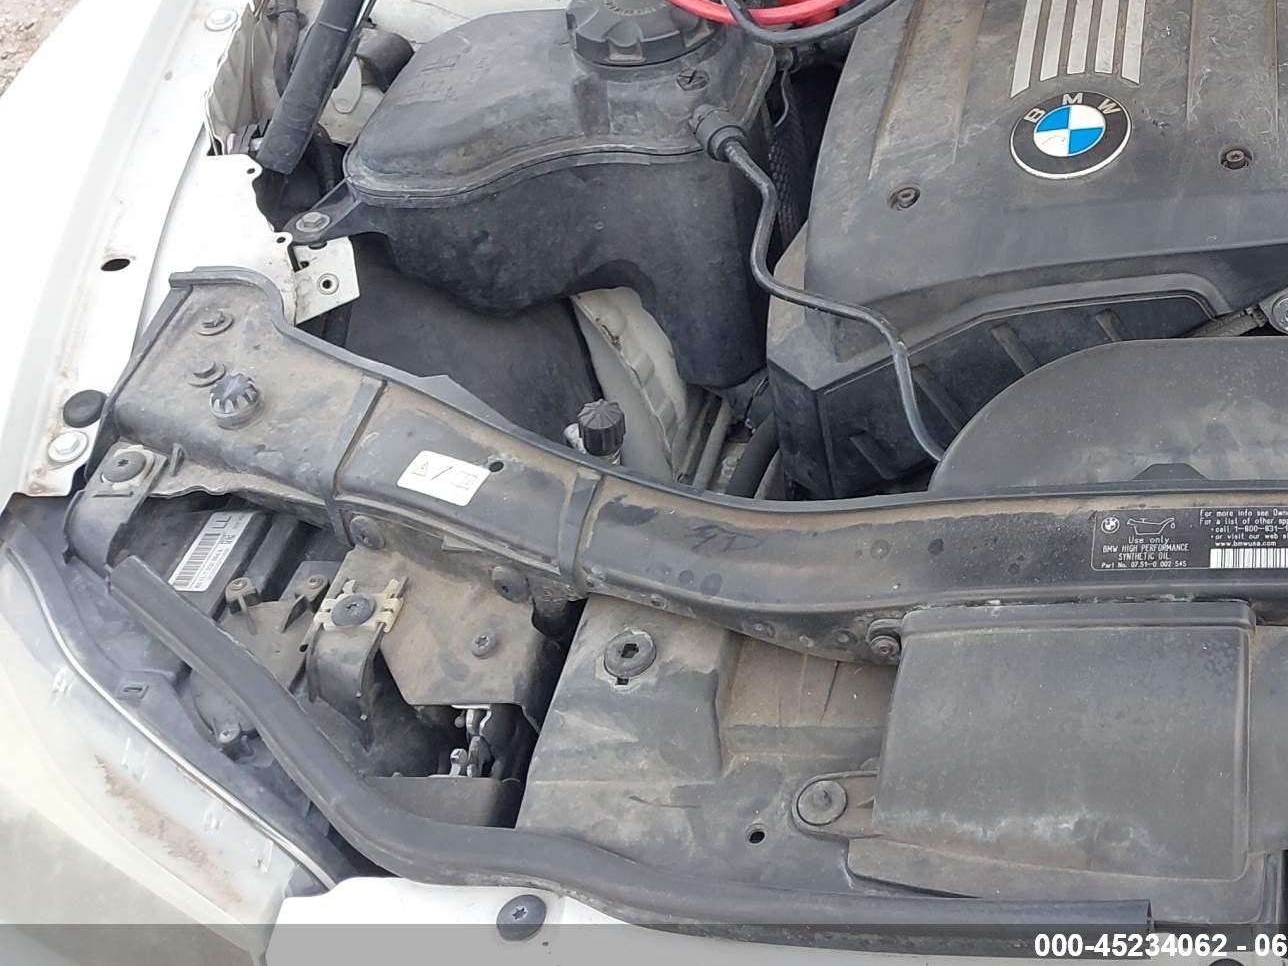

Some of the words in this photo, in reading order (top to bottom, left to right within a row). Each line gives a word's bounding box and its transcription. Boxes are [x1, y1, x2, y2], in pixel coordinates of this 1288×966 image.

[1200, 509, 1212, 517] For
[1238, 509, 1252, 517] info
[1200, 517, 1213, 525] For
[1225, 517, 1238, 525] list
[1242, 517, 1250, 525] of
[1128, 535, 1144, 544] Use
[1149, 535, 1170, 545] only
[1102, 545, 1118, 554] BMW
[1121, 544, 1138, 552] HIGH
[1141, 543, 1190, 552] PERFORMANCE
[1118, 552, 1155, 561] SYNTHETIC
[1158, 552, 1170, 560] OIL
